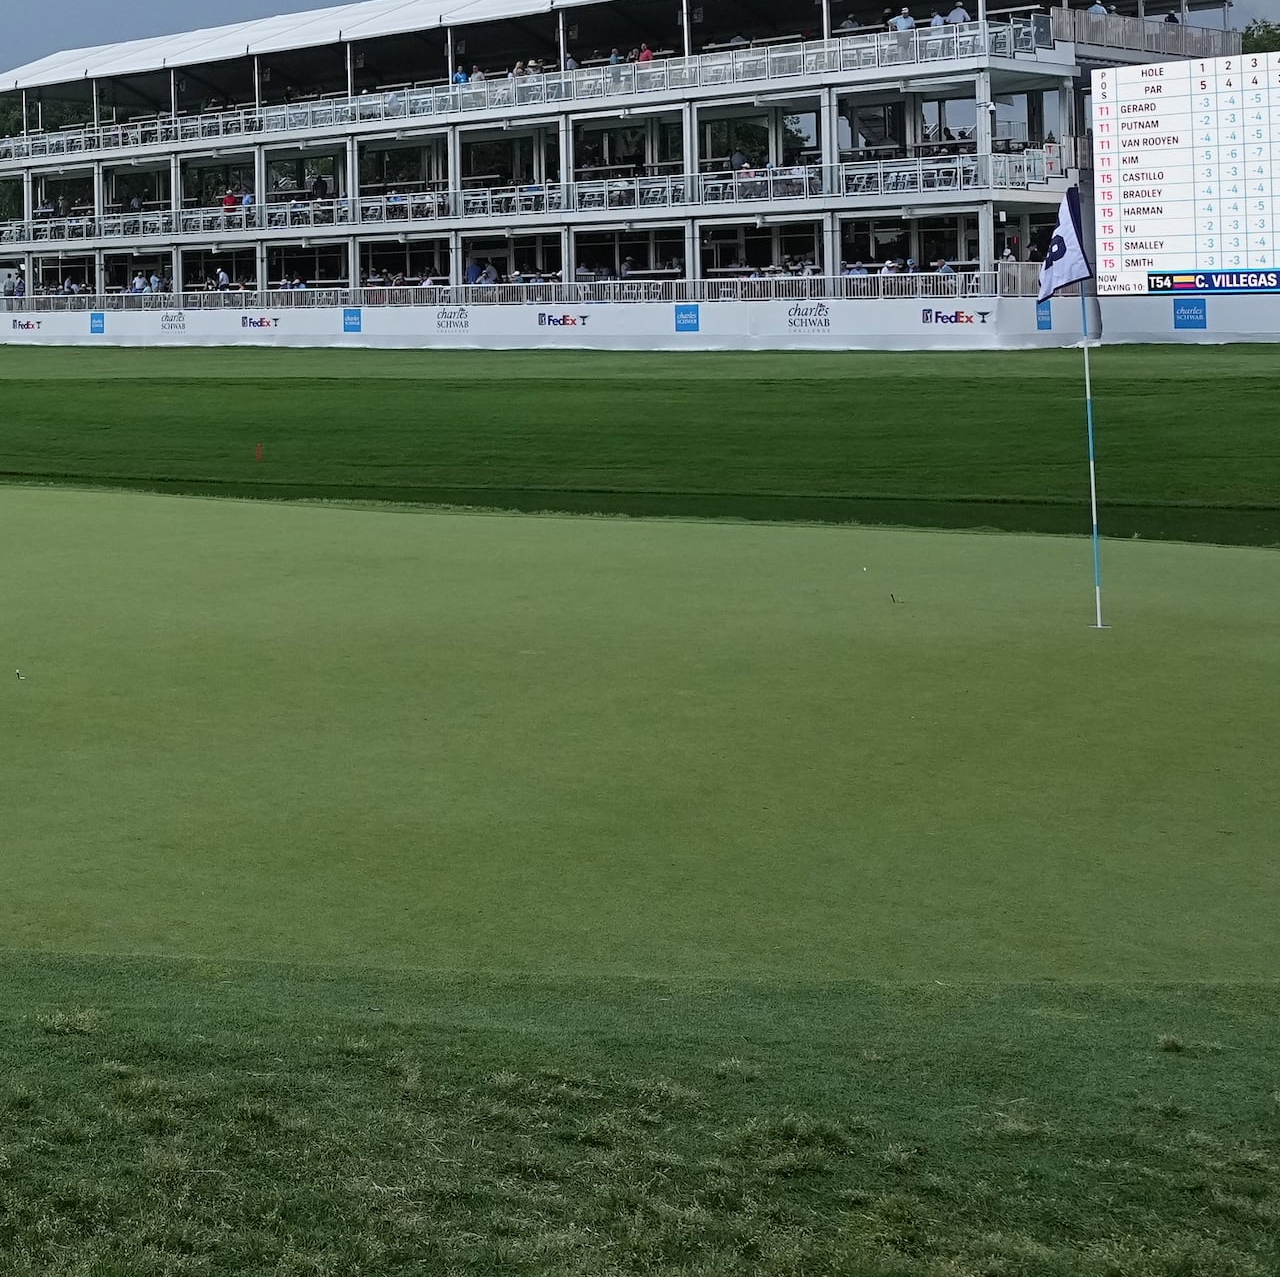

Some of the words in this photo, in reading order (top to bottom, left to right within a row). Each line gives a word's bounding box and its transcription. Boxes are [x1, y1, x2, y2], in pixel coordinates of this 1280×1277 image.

[1141, 68, 1164, 77] HOLE
[1201, 64, 1205, 73] 1
[1225, 61, 1232, 70] 2
[1251, 58, 1258, 68] 3
[1144, 85, 1162, 94] PAR
[1200, 81, 1206, 90] 5
[1225, 78, 1232, 87] 4
[1251, 76, 1258, 85] 4
[1120, 103, 1157, 114] GERARD
[1121, 120, 1159, 131] PUTNAM
[1121, 139, 1140, 148] VAN
[1142, 136, 1179, 146] ROOYEN
[1122, 156, 1139, 165] KIM
[1122, 172, 1164, 182] CASTILLO
[1123, 189, 1163, 199] BRADLEY
[1123, 206, 1163, 216] HARMAN
[1124, 240, 1164, 250] SMALLEY
[1124, 258, 1154, 268] SMITH
[1098, 275, 1117, 283] NOW
[1149, 276, 1172, 288] T54
[1195, 275, 1209, 288] C.
[1212, 273, 1277, 288] VILLEGAS
[1098, 284, 1131, 292] PLAYING
[436, 307, 468, 320] charles
[788, 303, 829, 317] charles
[1176, 307, 1203, 315] charles
[547, 315, 577, 326] FedEx
[788, 318, 831, 327] SCHWAB
[935, 311, 974, 324] FedEx
[248, 318, 271, 328] FedEx
[436, 320, 469, 328] SCHWAB
